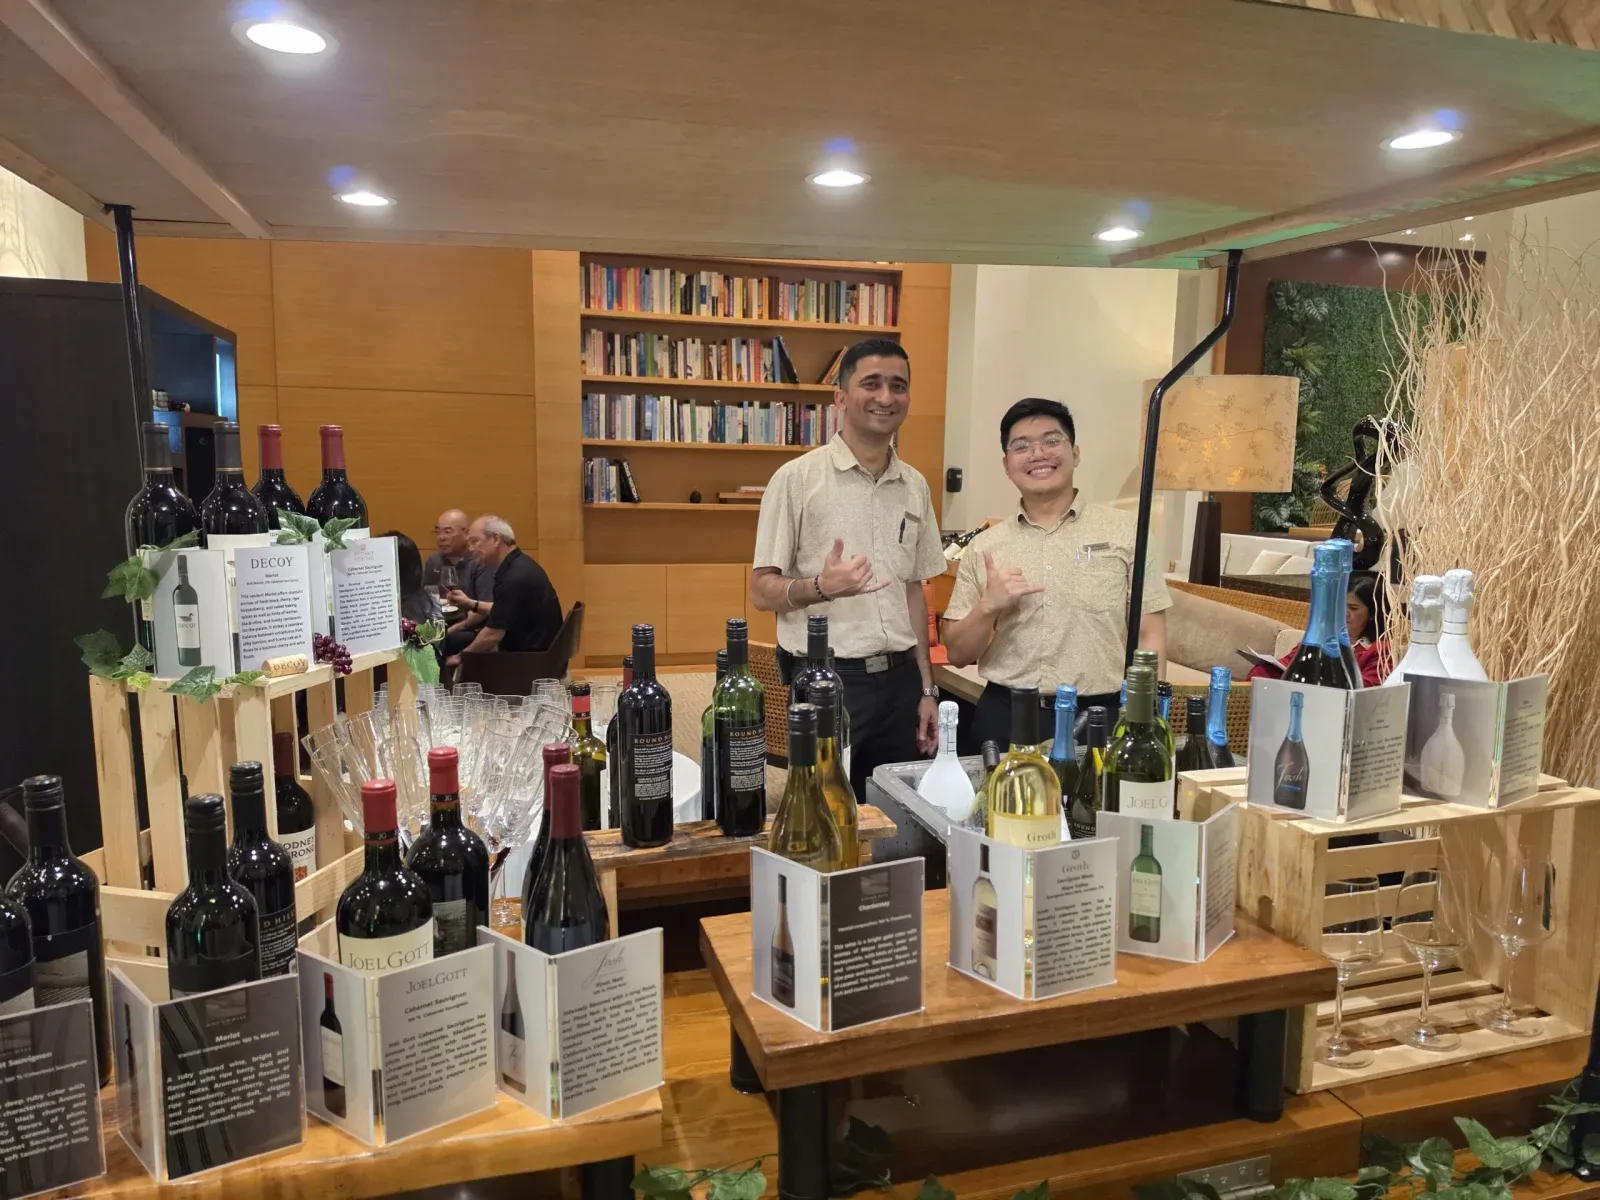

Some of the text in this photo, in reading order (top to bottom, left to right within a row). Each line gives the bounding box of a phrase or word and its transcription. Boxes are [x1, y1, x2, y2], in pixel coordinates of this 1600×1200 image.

[251, 557, 293, 569] DECOY
[273, 658, 306, 670] DECOY
[1027, 829, 1056, 842] Groth
[292, 844, 314, 859] RONG
[858, 900, 890, 911] Chardonnay
[596, 979, 610, 988] Pinot
[404, 1000, 432, 1014] Cabernet
[434, 990, 466, 1004] Sauvignon
[215, 1031, 240, 1042] Merlot
[7, 1052, 52, 1066] Sauvignon
[177, 1072, 194, 1080] ruby
[198, 1063, 224, 1075] colored
[251, 1052, 272, 1062] bright
[276, 1047, 289, 1056] and
[167, 1079, 195, 1092] flavorful
[199, 1074, 215, 1084] with
[259, 1060, 273, 1068] fruit
[277, 1056, 289, 1064] and
[269, 1073, 290, 1083] vanilla
[167, 1092, 185, 1101] spice
[214, 1078, 238, 1089] Aromas
[242, 1073, 254, 1081] and
[258, 1068, 279, 1077] flavors
[4, 1083, 85, 1107] deep ruby color with
[58, 1092, 85, 1103] Aromas
[168, 1109, 181, 1118] and
[187, 1104, 202, 1113] dark
[266, 1081, 290, 1092] elegant
[14, 1100, 86, 1123] black cherry and
[209, 1107, 225, 1116] with
[230, 1099, 253, 1110] refined
[259, 1094, 271, 1103] and
[17, 1121, 42, 1131] flavors
[0, 1135, 14, 1144] and
[0, 1125, 88, 1154] bernet Sauvignon with
